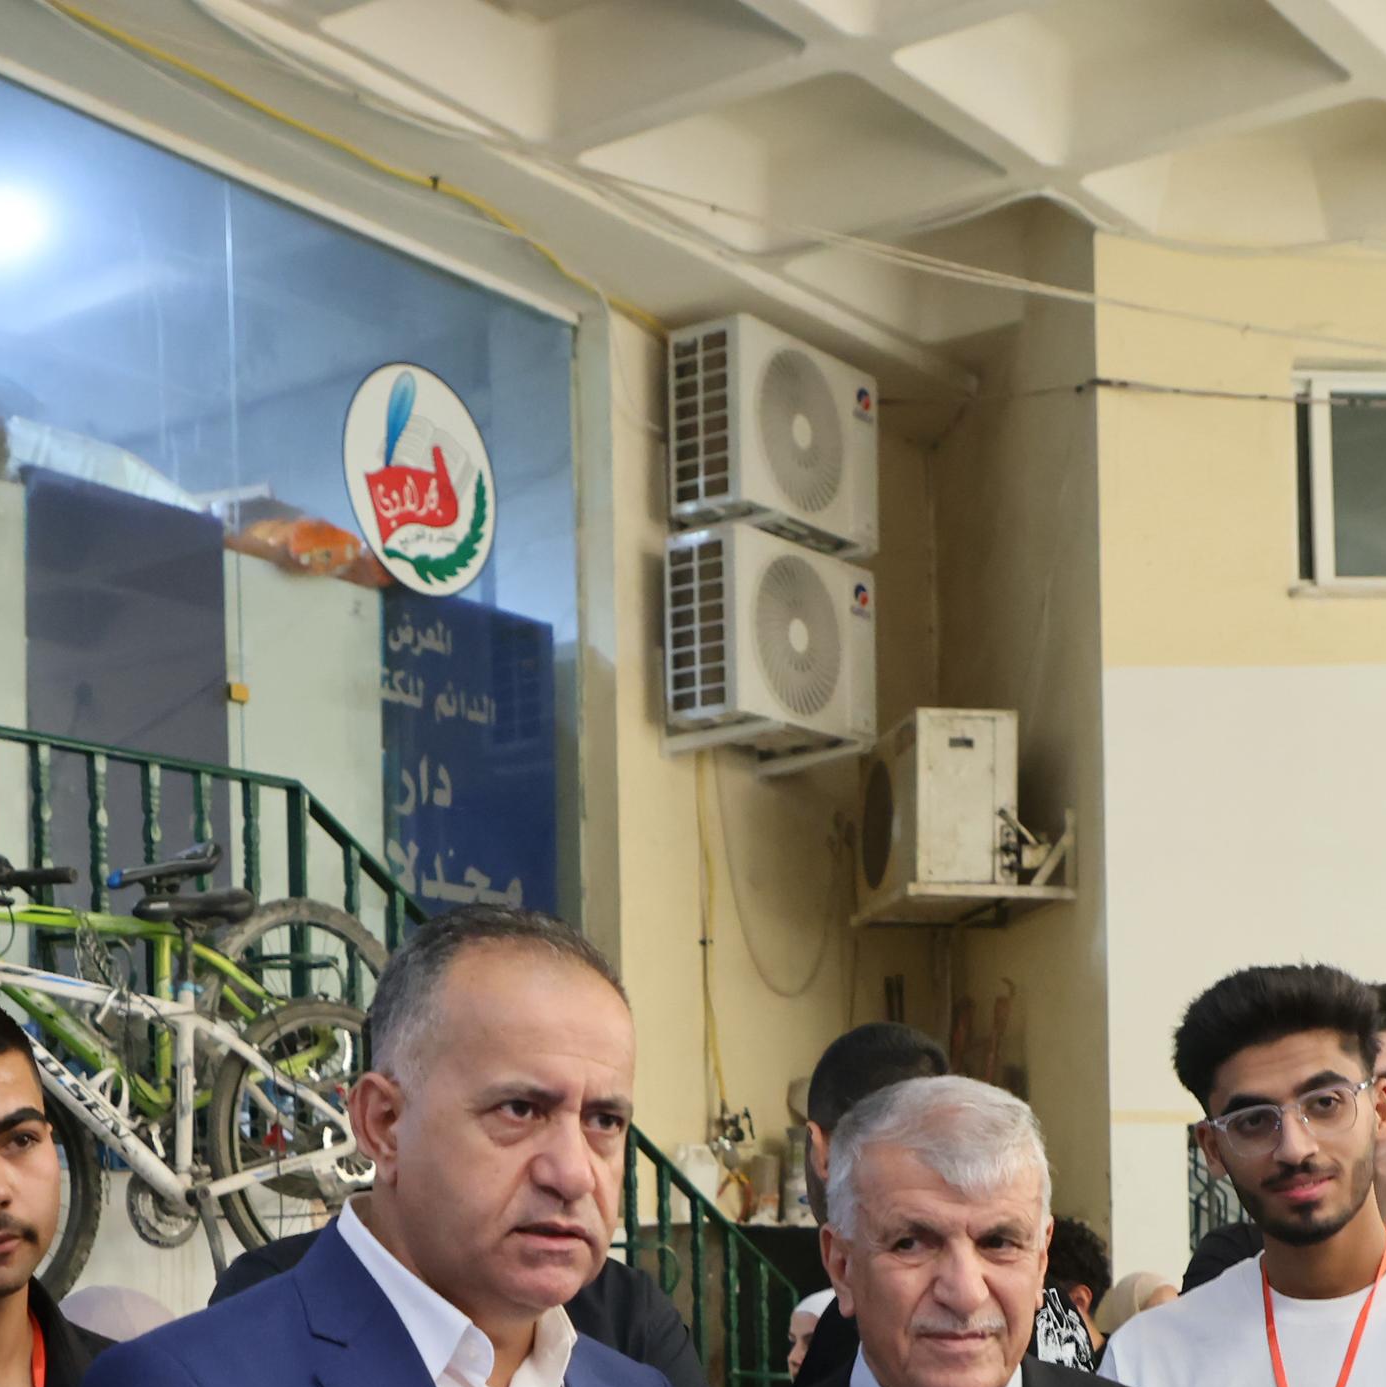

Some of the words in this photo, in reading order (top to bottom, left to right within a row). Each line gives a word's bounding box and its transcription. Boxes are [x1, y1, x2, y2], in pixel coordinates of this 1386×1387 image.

[388, 612, 453, 656] المعرض
[434, 680, 497, 726] الدائم
[392, 752, 453, 816] دار
